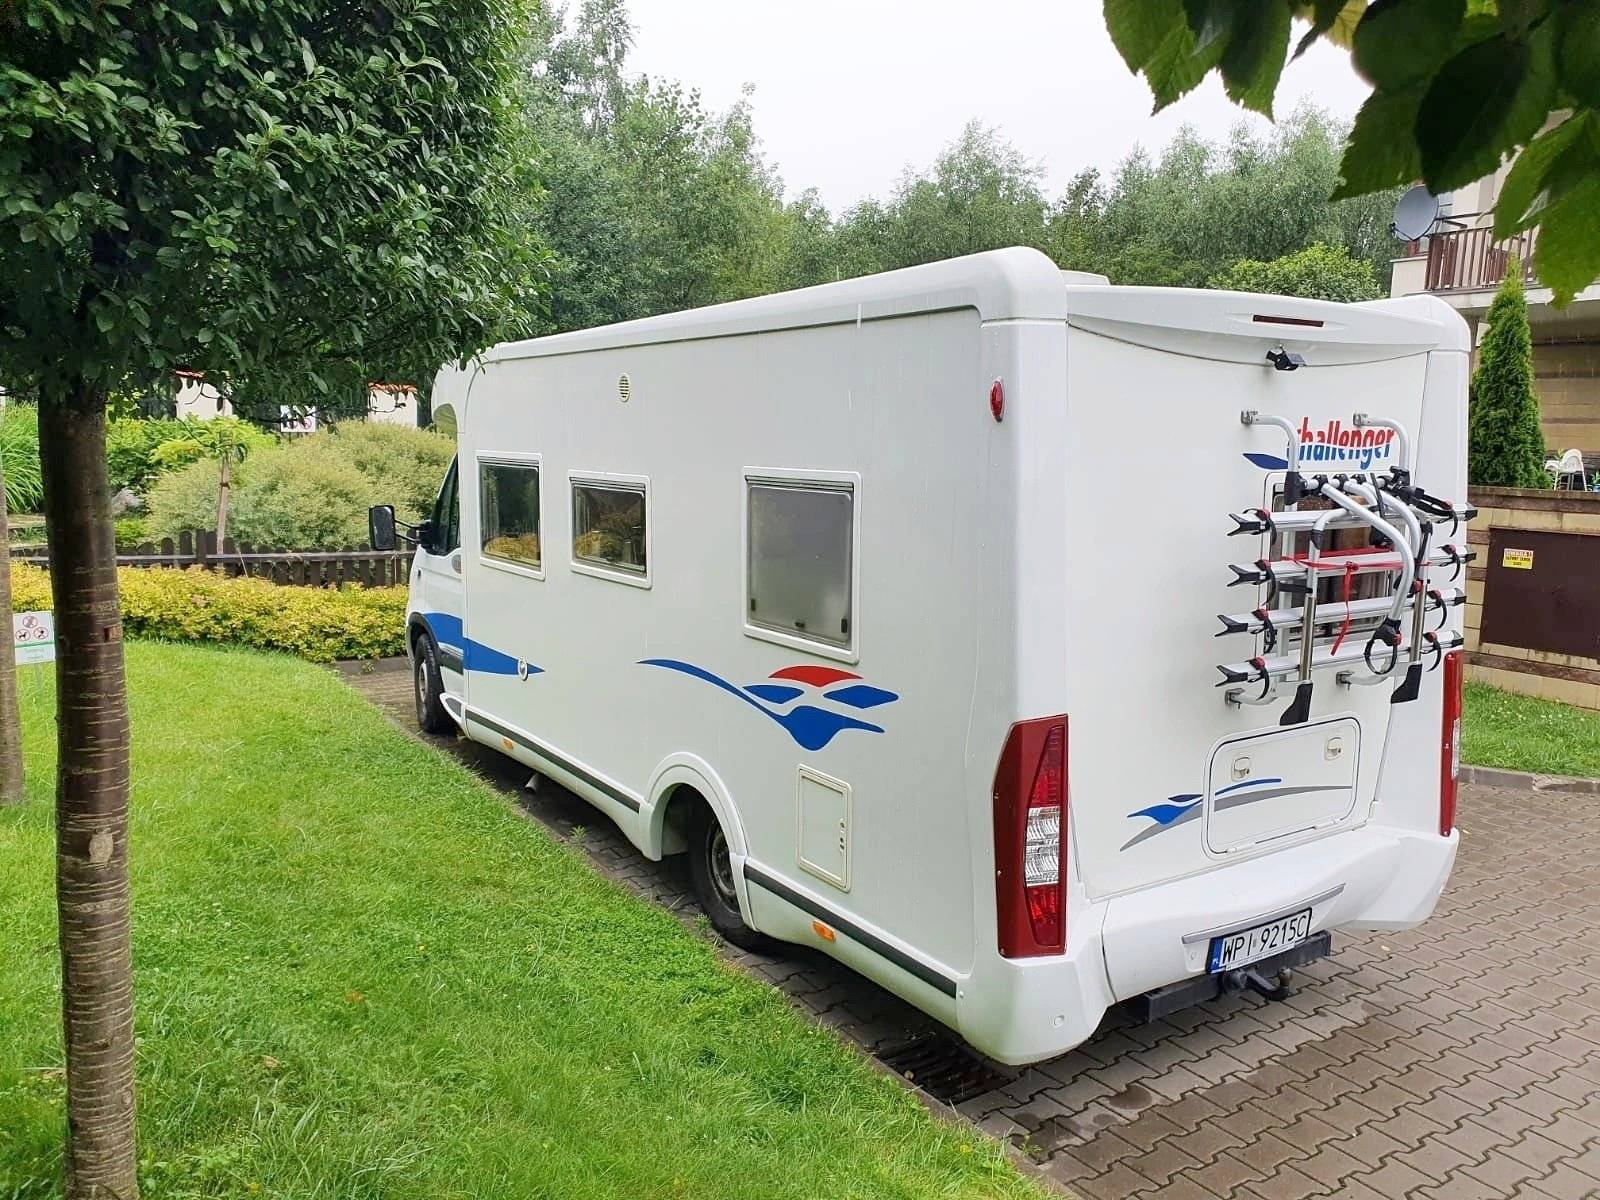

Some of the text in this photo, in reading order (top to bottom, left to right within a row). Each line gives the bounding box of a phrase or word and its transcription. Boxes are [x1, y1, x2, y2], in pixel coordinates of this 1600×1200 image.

[1287, 416, 1395, 470] hallenger
[1222, 933, 1253, 964] WPI
[1260, 915, 1307, 952] 9215C
